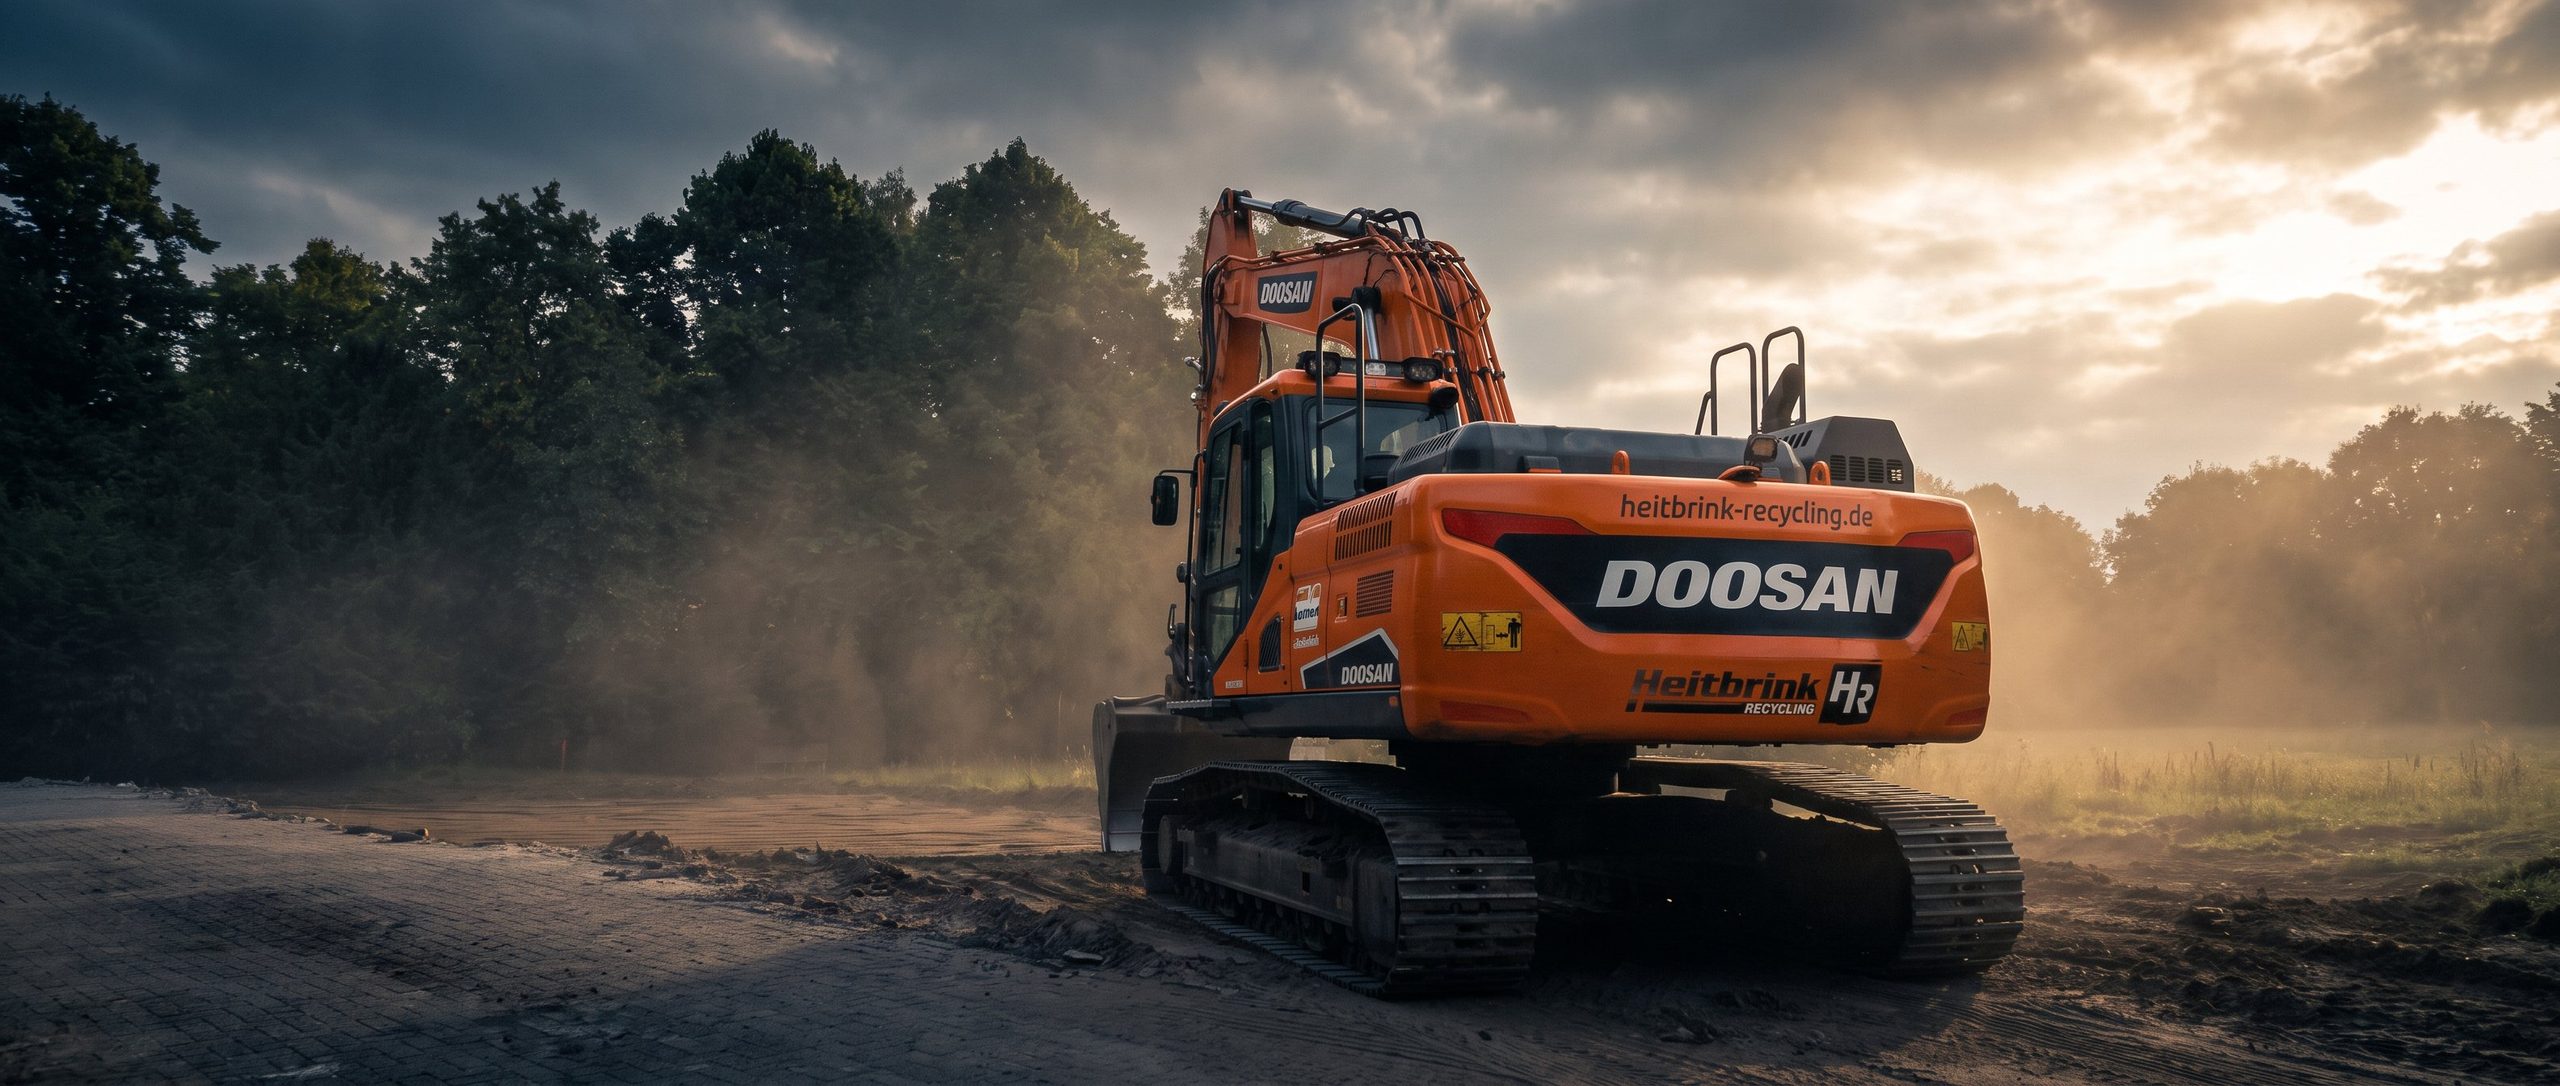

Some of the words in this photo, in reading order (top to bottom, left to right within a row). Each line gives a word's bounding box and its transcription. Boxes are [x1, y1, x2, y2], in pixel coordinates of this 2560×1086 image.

[1260, 280, 1313, 304] DOOSAN
[1620, 494, 1873, 530] heitbrink-recycling.de
[1596, 560, 1898, 614] DOOSAN
[1341, 662, 1394, 685] DOOSAN
[1630, 669, 1821, 701] Heitbrink
[1829, 670, 1874, 715] HR
[1743, 703, 1815, 715] RECYCLING
